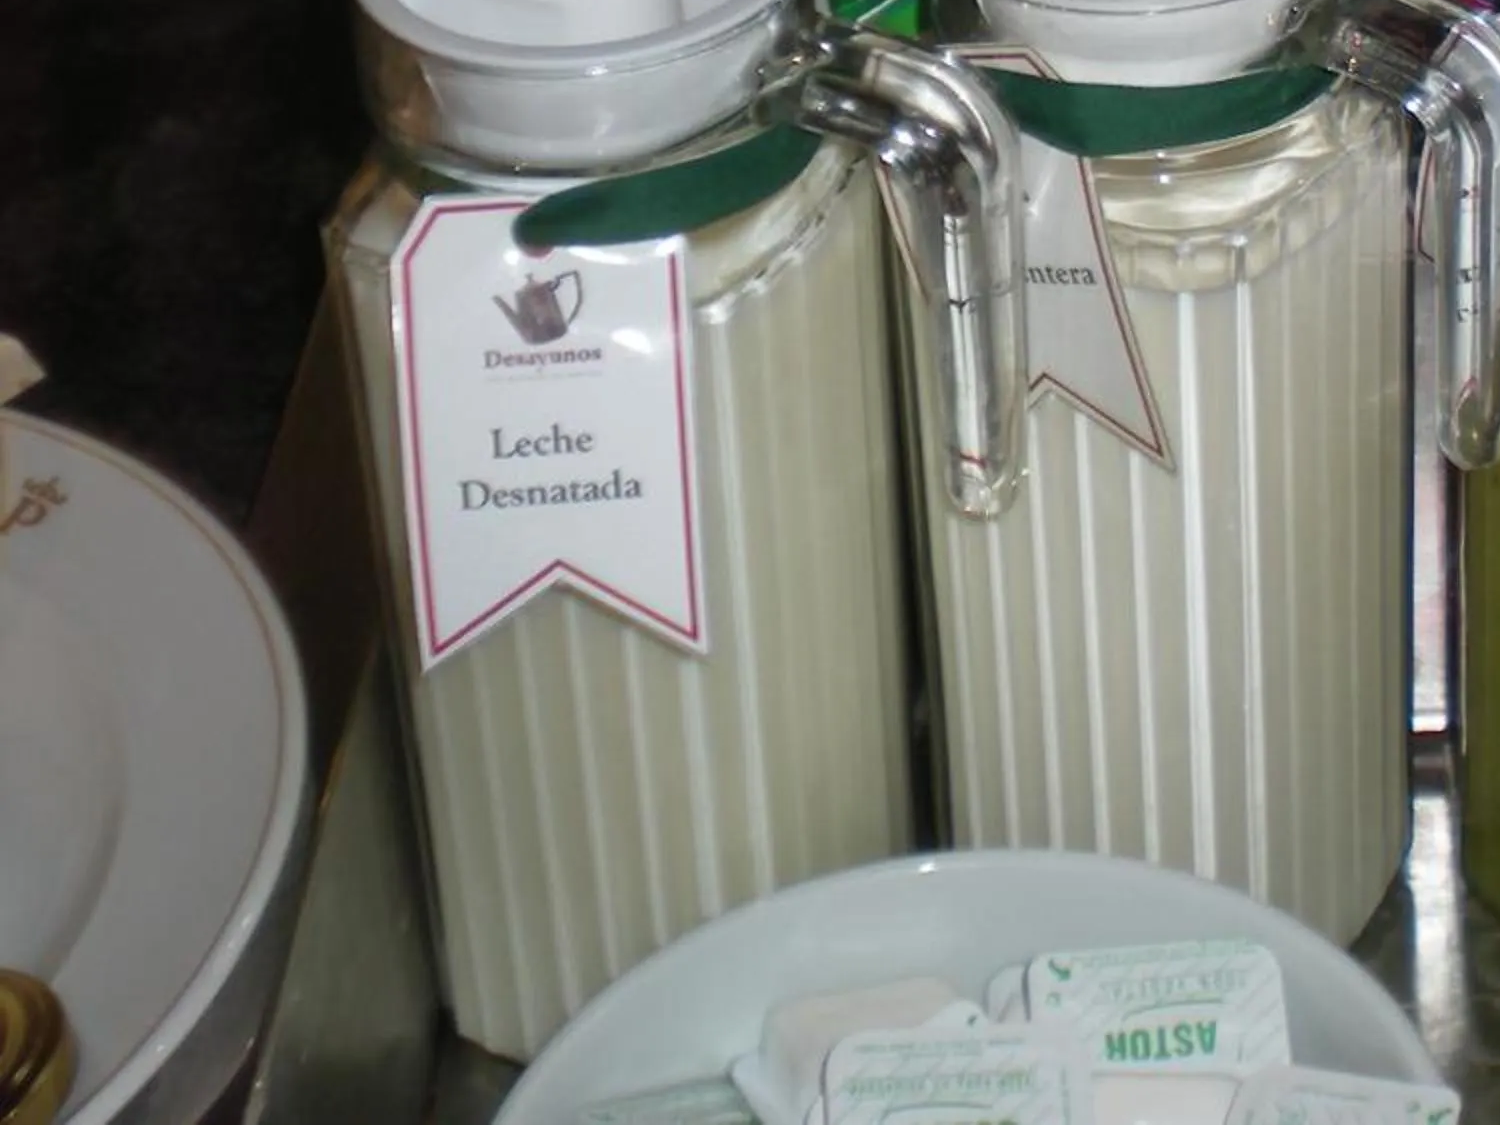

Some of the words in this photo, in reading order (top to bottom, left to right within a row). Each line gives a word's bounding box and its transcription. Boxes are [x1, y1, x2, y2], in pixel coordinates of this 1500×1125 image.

[1024, 264, 1098, 285] ntera
[483, 347, 603, 374] Desayunos
[490, 425, 594, 460] Leche
[460, 469, 643, 512] Desnatada
